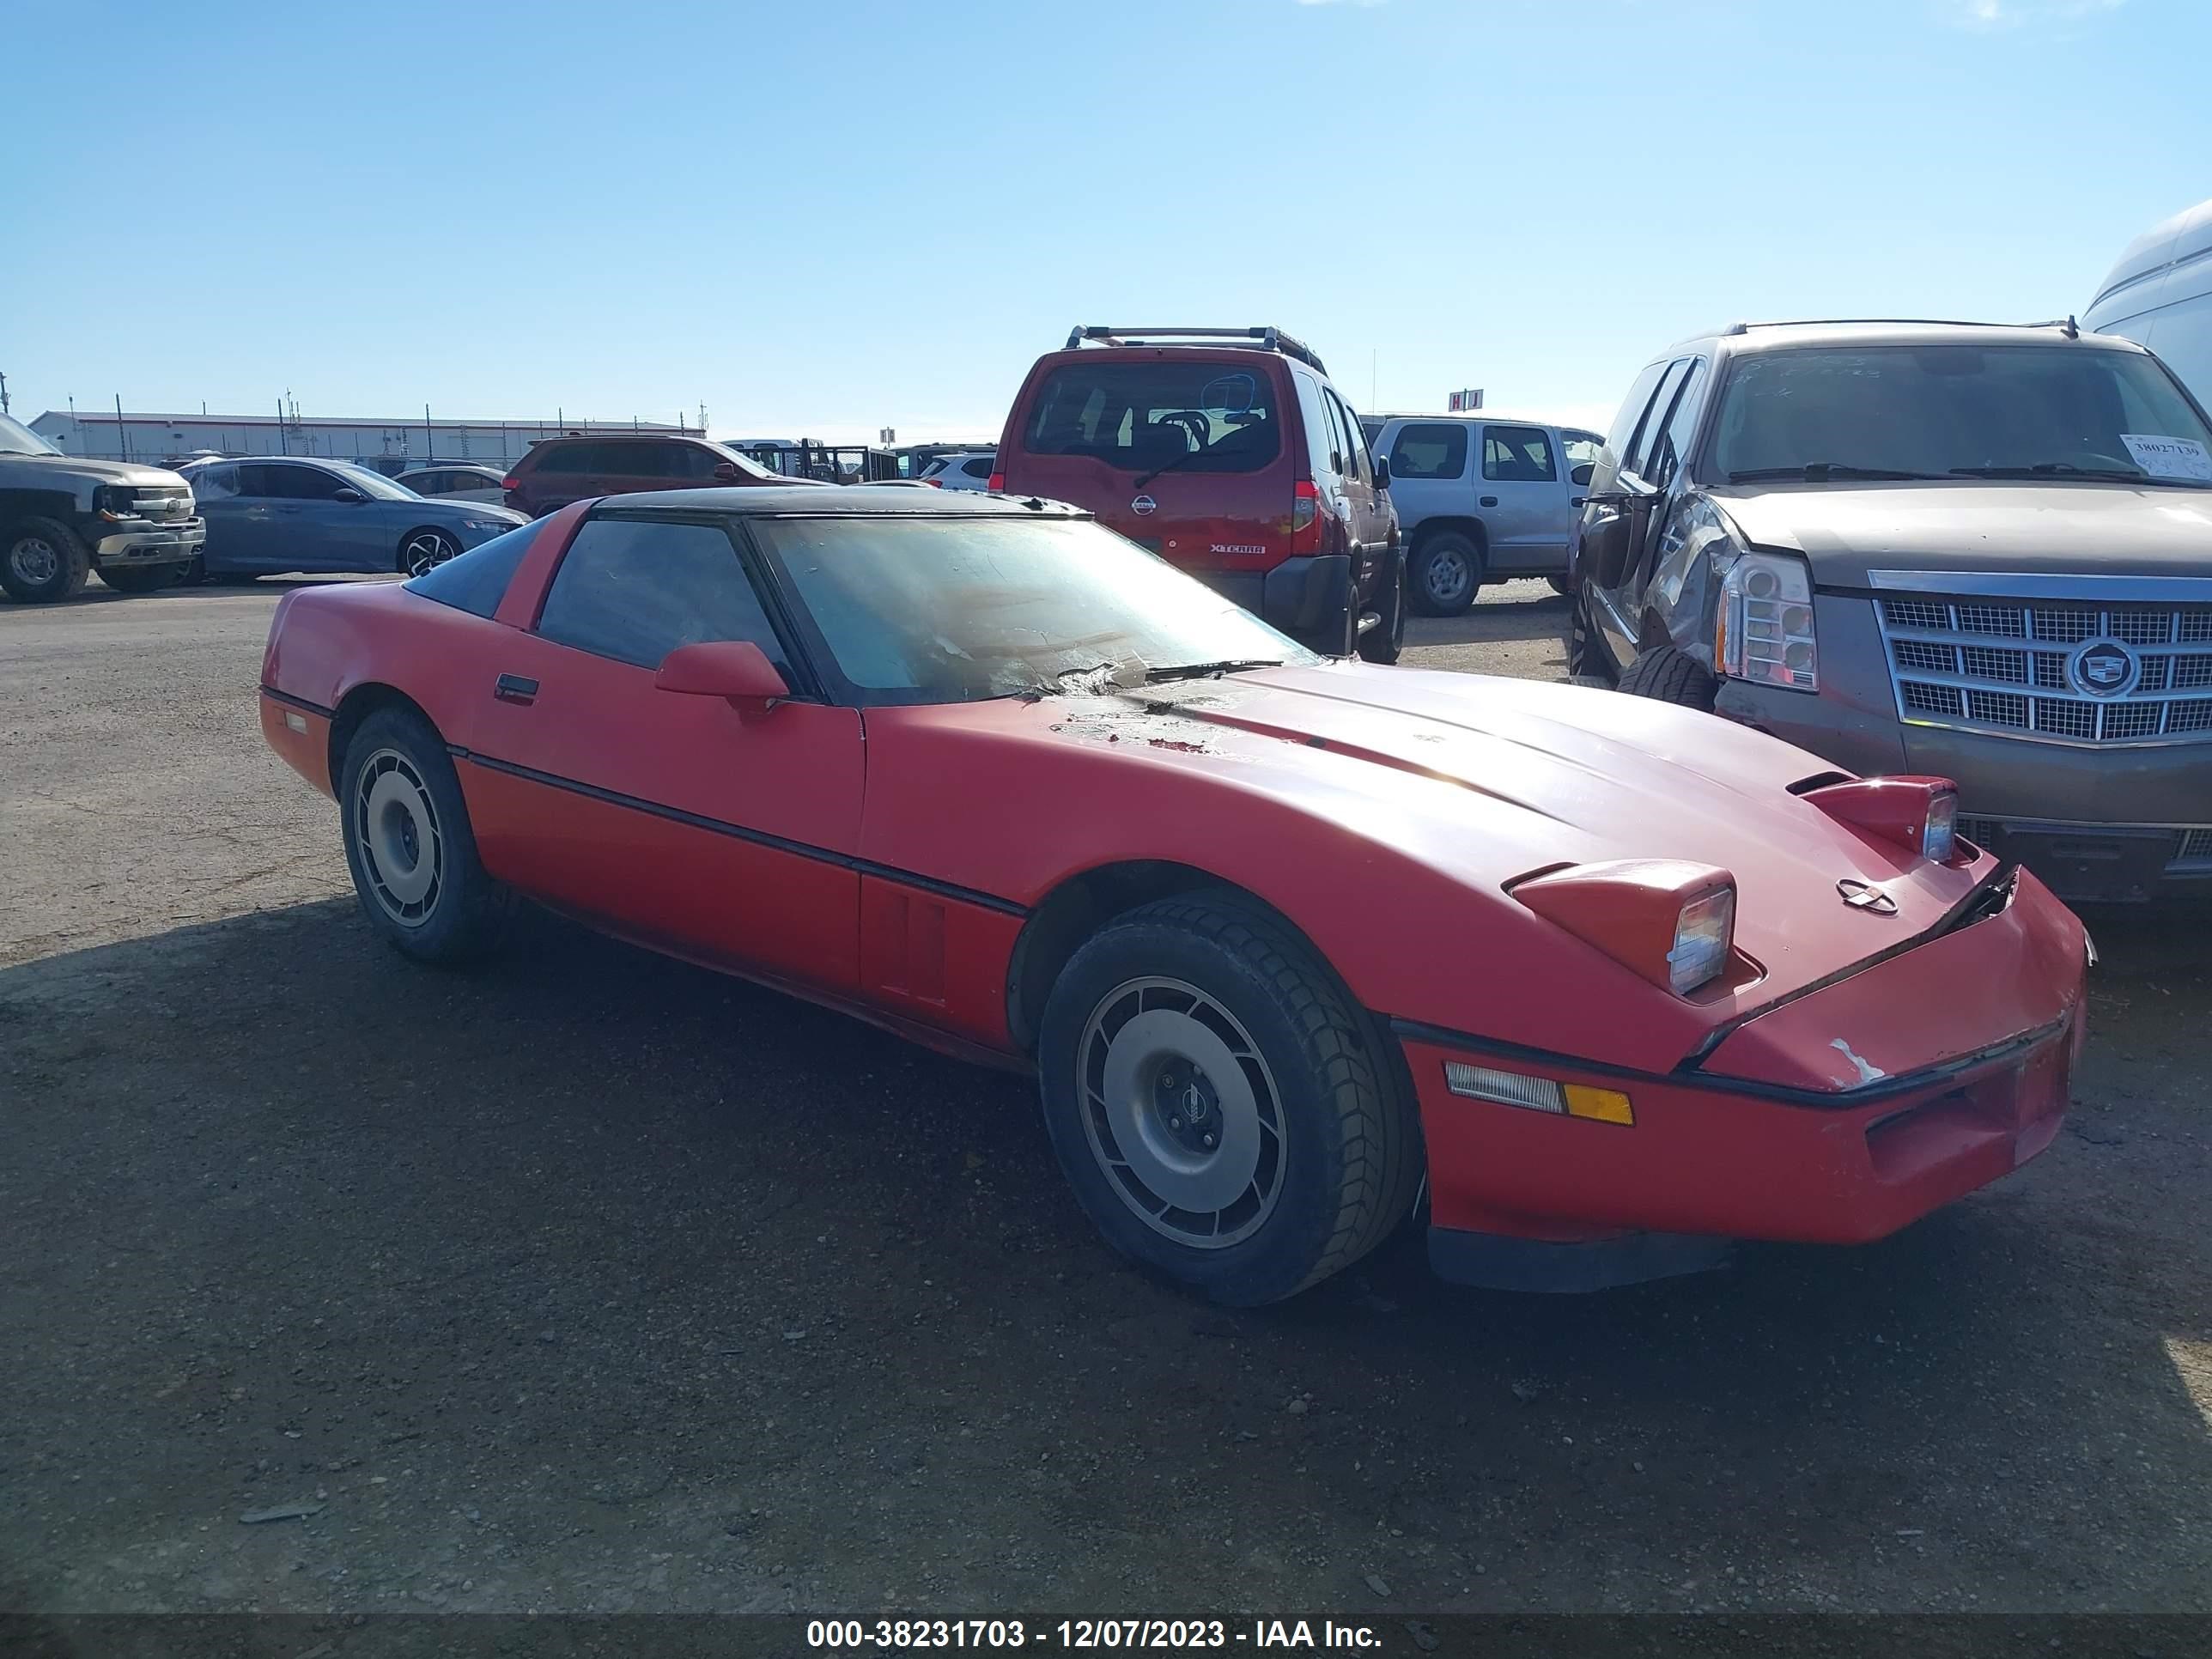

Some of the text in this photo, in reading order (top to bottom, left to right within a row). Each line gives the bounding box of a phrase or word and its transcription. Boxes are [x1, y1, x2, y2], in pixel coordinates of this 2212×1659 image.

[1452, 394, 1461, 410] H
[1472, 392, 1478, 407] J
[2135, 443, 2200, 456] 38027139
[1210, 544, 1266, 554] XTERRA
